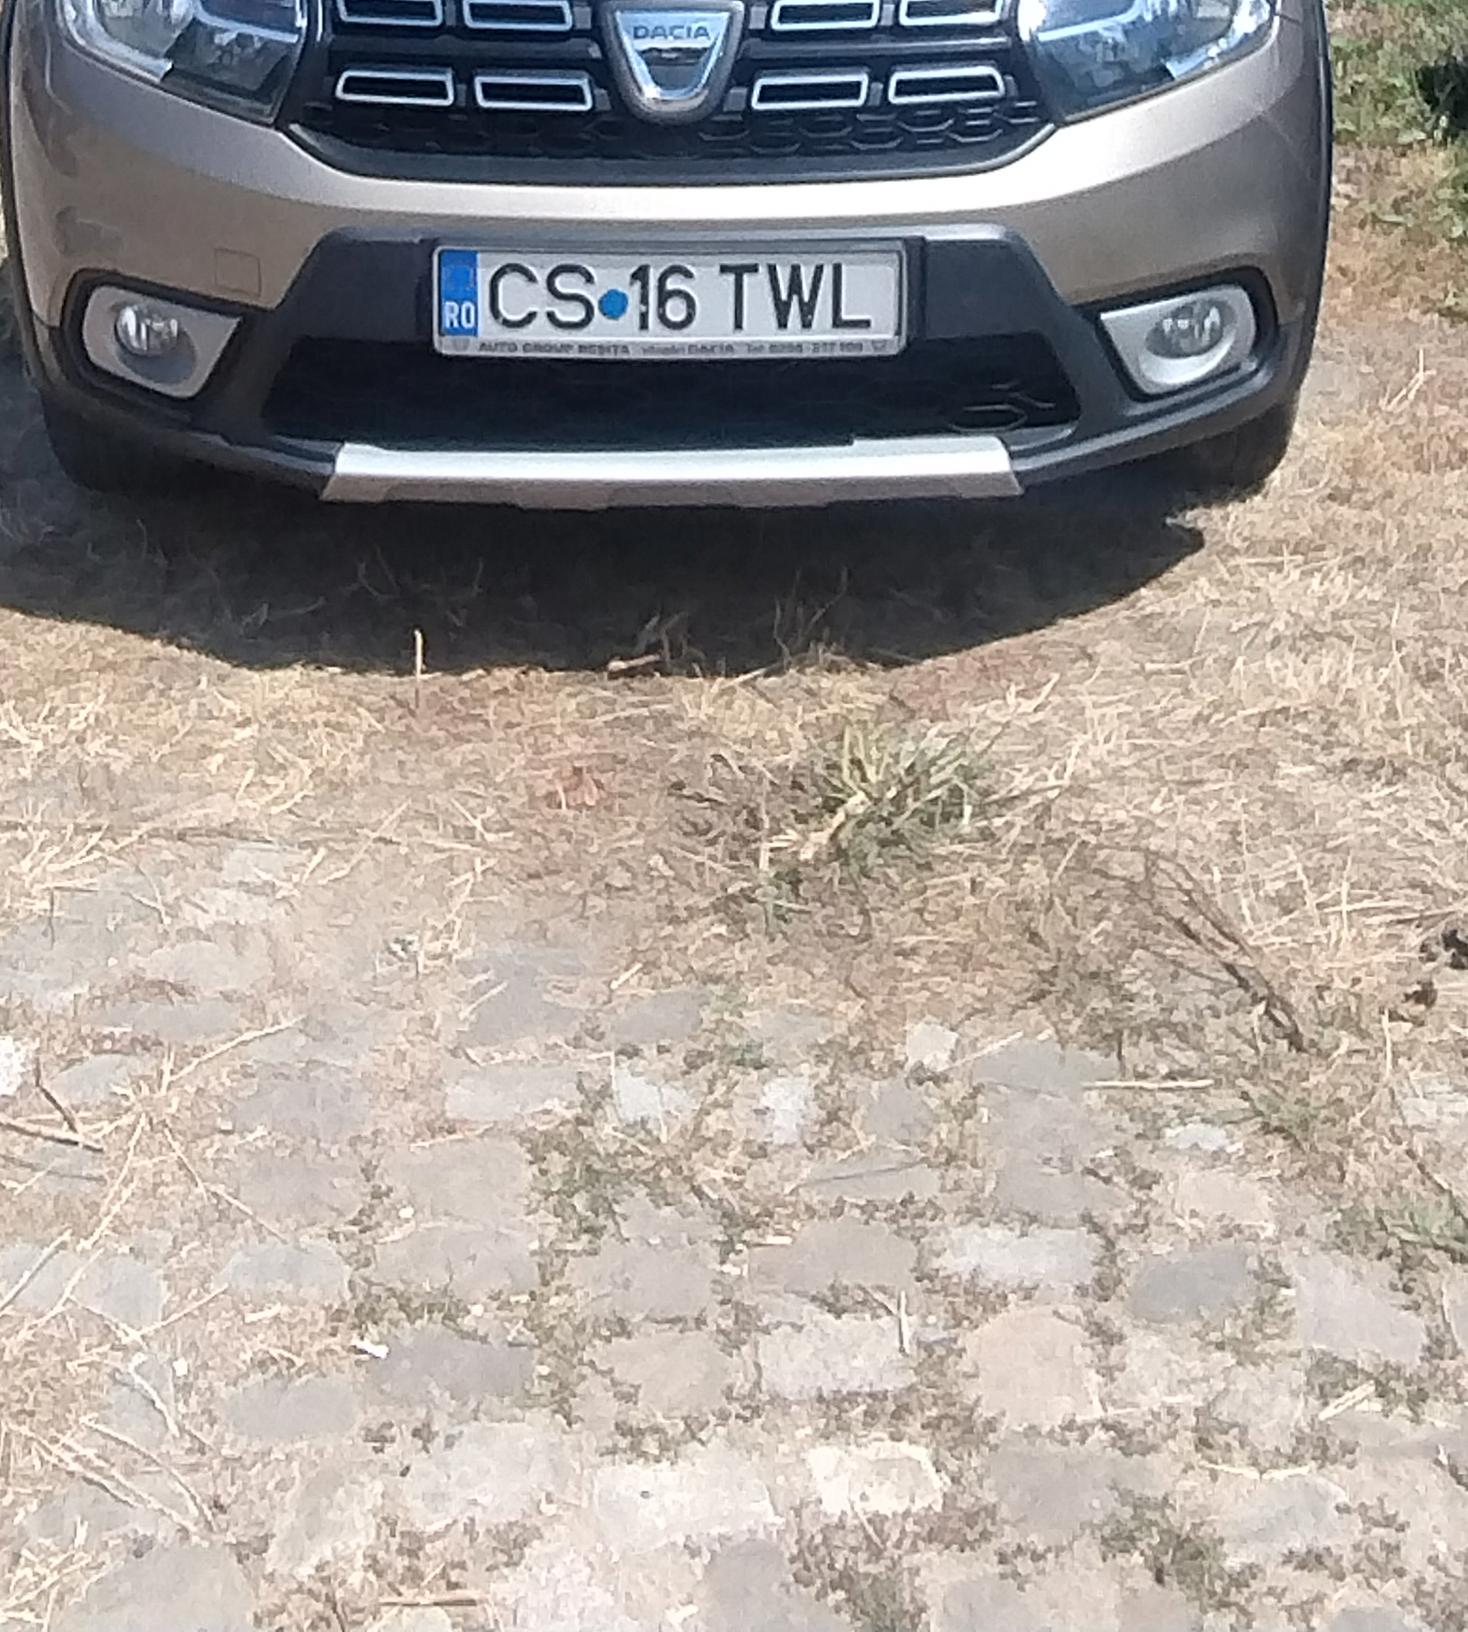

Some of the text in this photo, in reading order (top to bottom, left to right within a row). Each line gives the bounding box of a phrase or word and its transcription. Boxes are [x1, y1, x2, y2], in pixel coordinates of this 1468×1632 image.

[633, 24, 711, 40] DACIA
[487, 261, 873, 331] CS 16 TWL
[444, 300, 476, 329] RO
